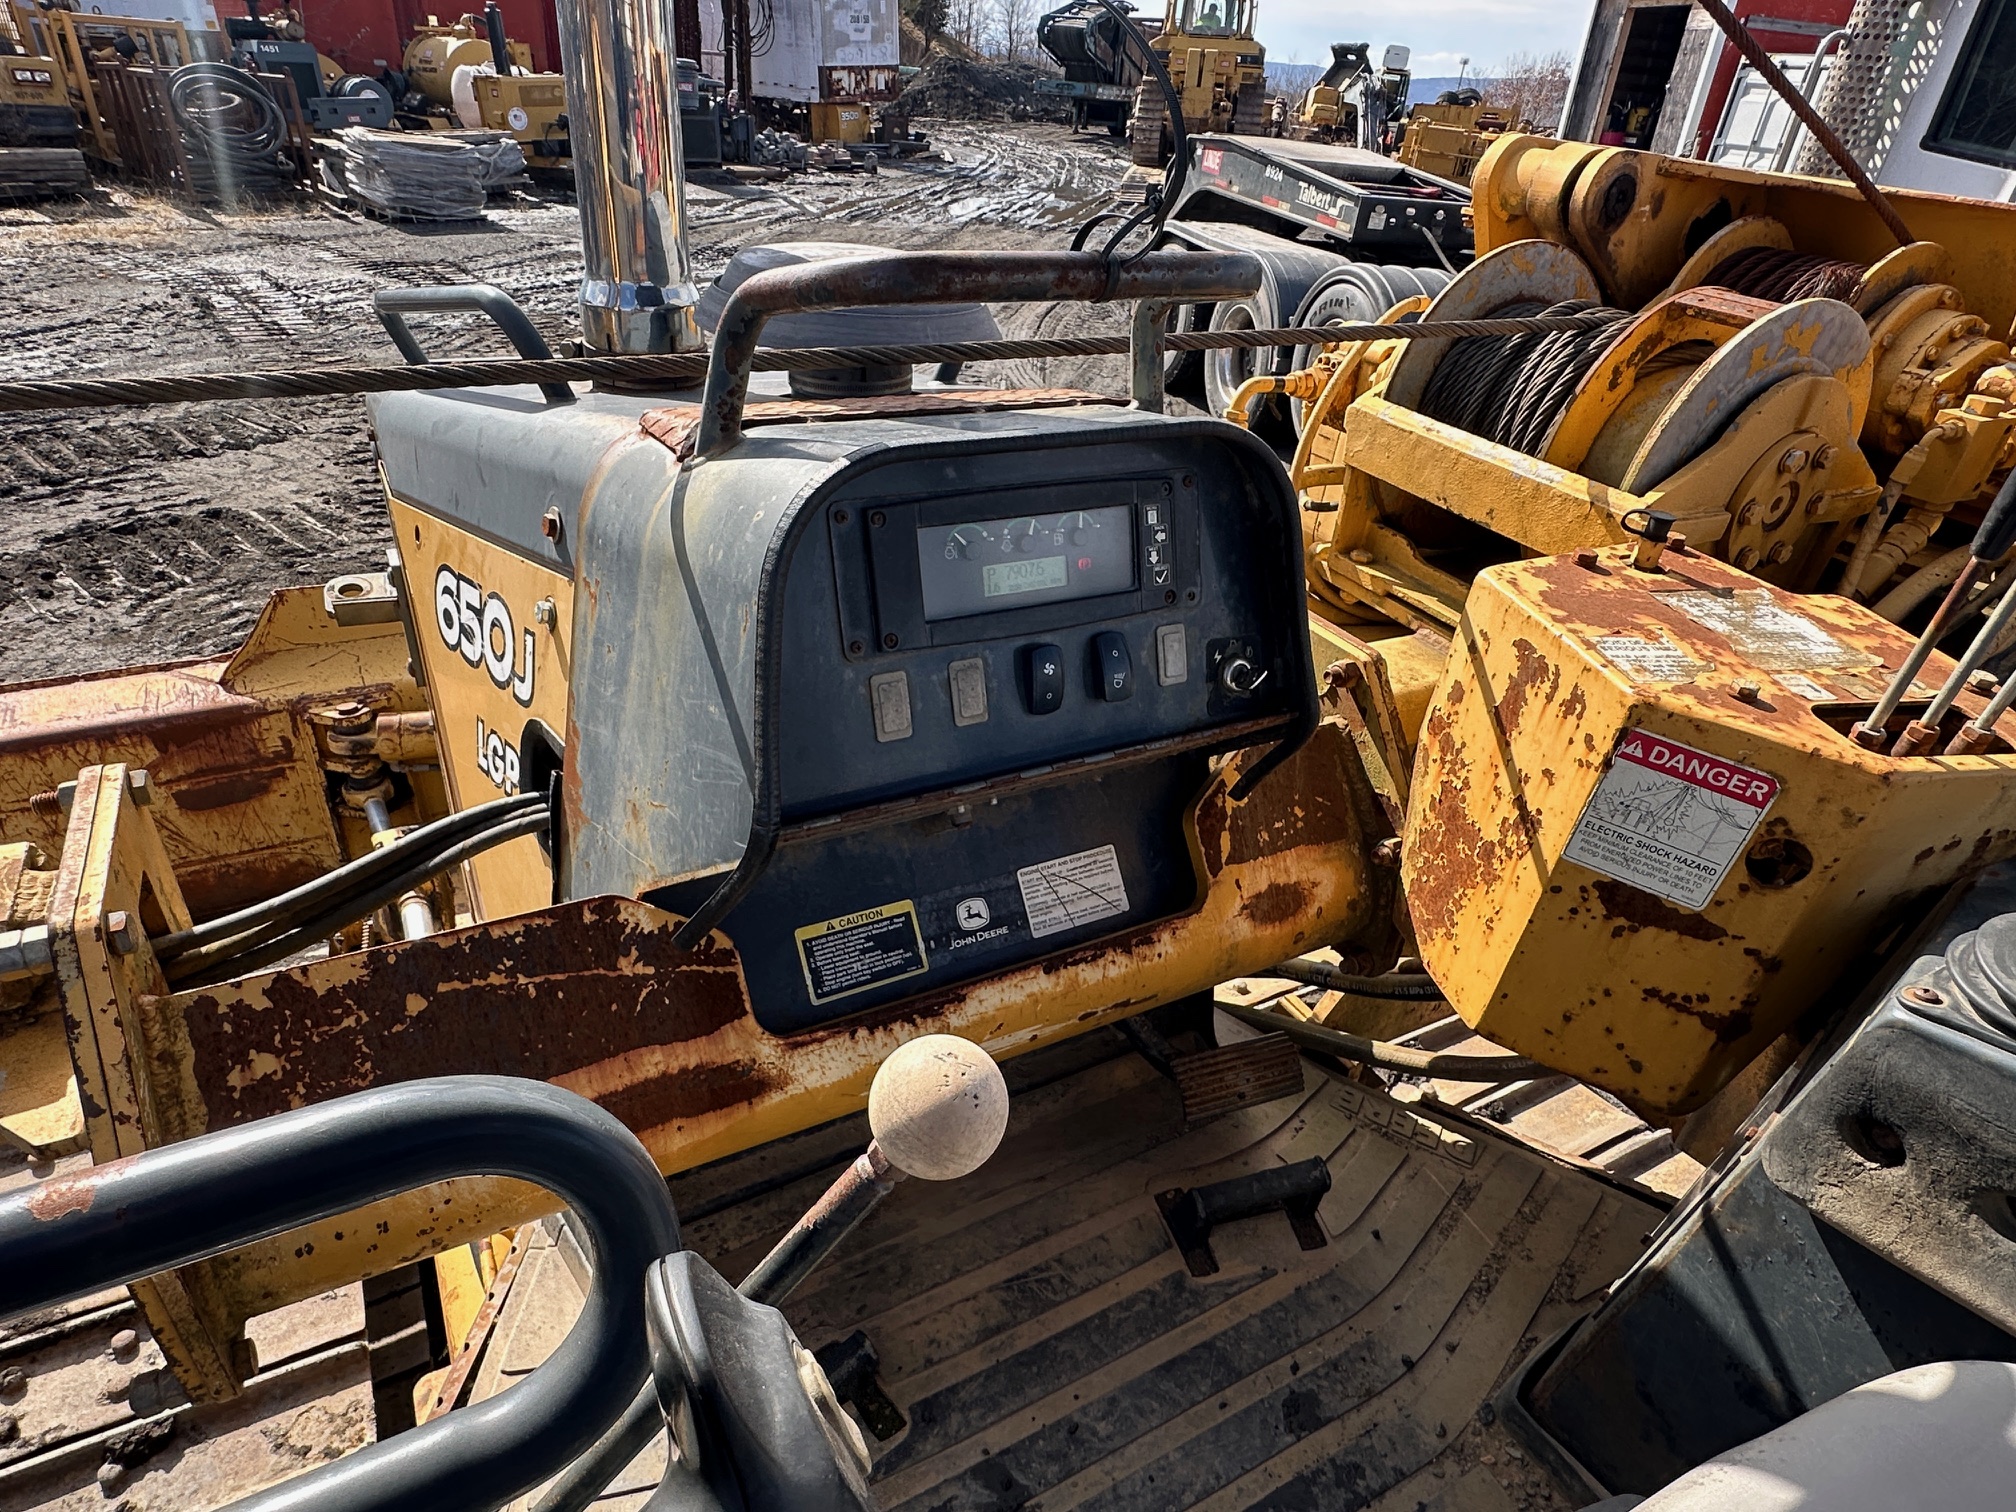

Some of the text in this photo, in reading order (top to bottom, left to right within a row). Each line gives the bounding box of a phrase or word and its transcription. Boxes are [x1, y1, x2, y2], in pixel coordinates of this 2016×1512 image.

[260, 44, 280, 53] 1451
[1265, 164, 1284, 182] 8924
[1298, 181, 1332, 210] Talbert
[435, 563, 536, 708] 650J
[476, 714, 521, 797] LGP
[1648, 745, 1770, 802] DANGER
[1041, 863, 1057, 871] START
[1578, 827, 1713, 885] KEEP MINIMUM CLEARANCE OF 10 FEET
[1578, 845, 1695, 895] AVOID SERIOUS INJURY OR DEATH
[1580, 837, 1602, 850] FROM
[1642, 861, 1670, 876] POWER
[1669, 872, 1692, 885] LINES
[1690, 881, 1703, 890] TO
[1584, 820, 1718, 876] ELECTRIC SHOCK HAZARD
[838, 909, 884, 928] CAUTION
[948, 925, 1009, 949] JOHN DEERE
